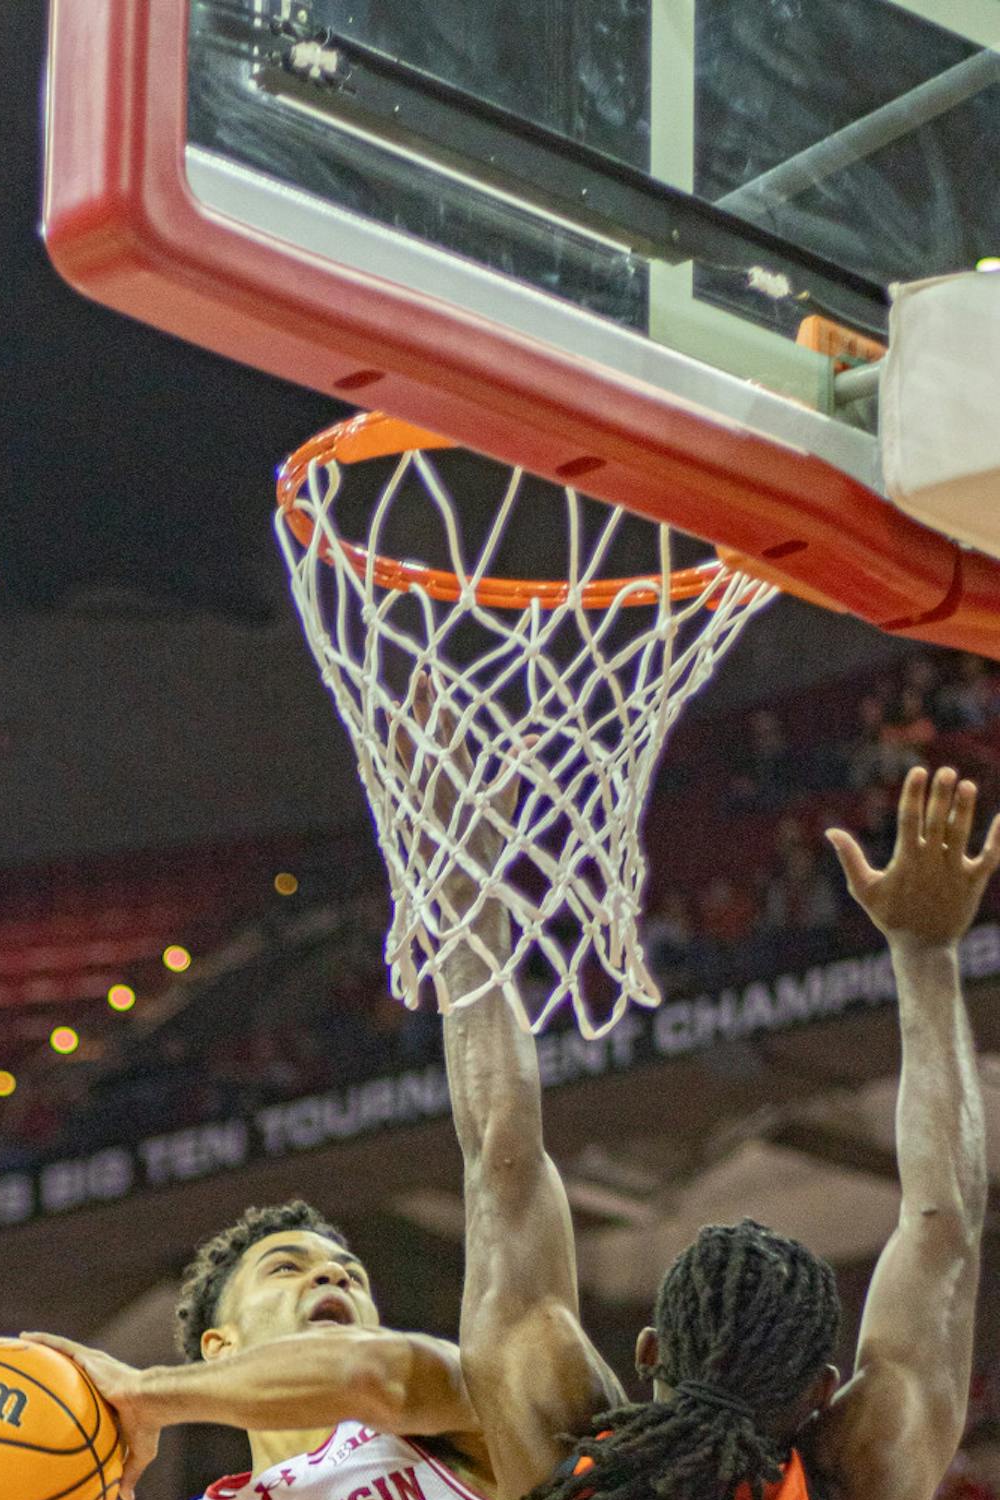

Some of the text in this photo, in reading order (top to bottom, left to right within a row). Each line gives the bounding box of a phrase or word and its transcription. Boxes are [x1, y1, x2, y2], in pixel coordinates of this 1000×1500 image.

[39, 1147, 134, 1212] BIG
[139, 1119, 248, 1185] TEN
[256, 1013, 640, 1156] TOURNENT
